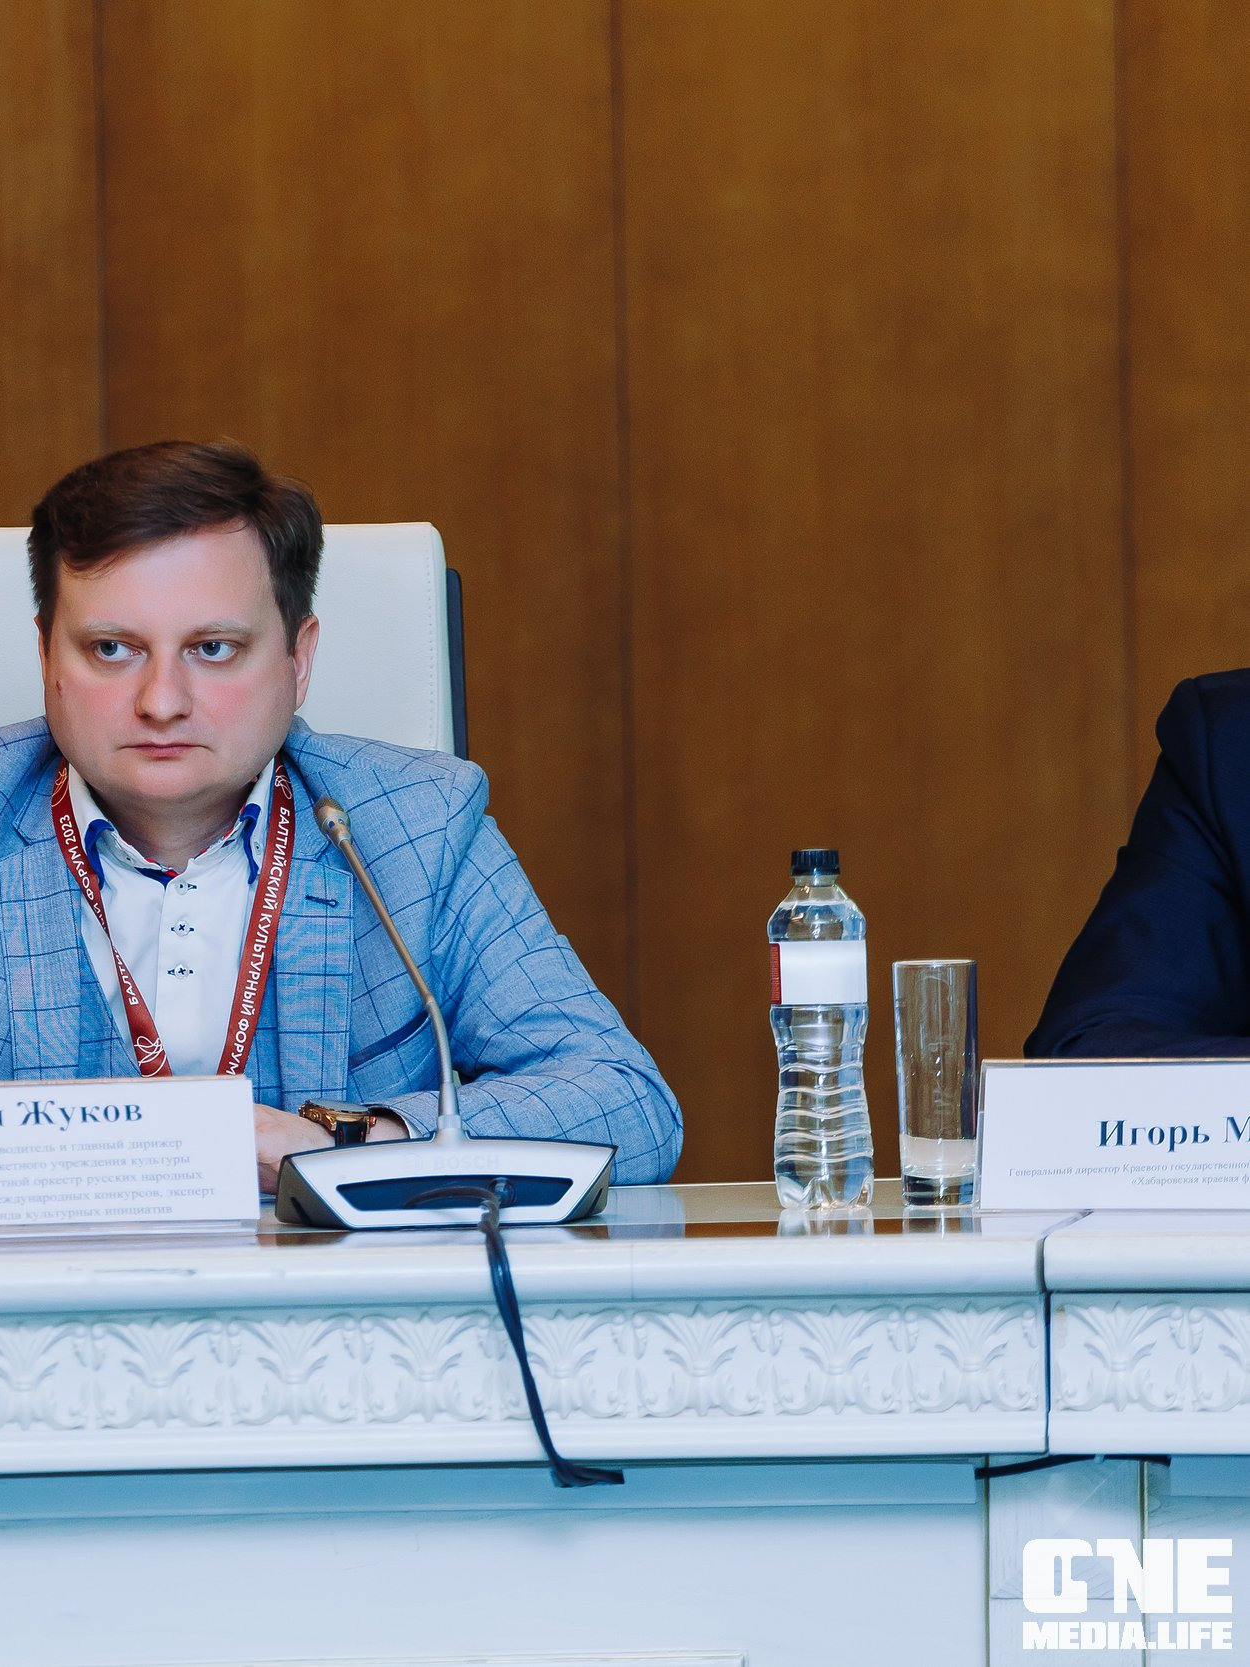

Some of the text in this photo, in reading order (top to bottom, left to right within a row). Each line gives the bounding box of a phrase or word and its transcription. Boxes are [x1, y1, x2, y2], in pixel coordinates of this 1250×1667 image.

[59, 814, 77, 846] 2023
[68, 845, 95, 901] ФОРУМ
[226, 806, 291, 1076] БАЛТИЙСКИЙ КУЛЬТУРНЫЙ ФОРУМ
[16, 1099, 144, 1132] Жуков
[1096, 1119, 1211, 1153] Игорь
[59, 1143, 68, 1152] и
[71, 1140, 125, 1152] главный
[50, 1157, 128, 1171] учреждения
[130, 1154, 191, 1168] культуры
[432, 1154, 500, 1170] BOSCH
[1008, 1166, 1073, 1178] Генеральный
[1074, 1164, 1121, 1176] директор
[1122, 1162, 1168, 1174] Краевого
[33, 1175, 83, 1188] оркестр
[86, 1173, 138, 1186] русских
[140, 1170, 205, 1184] народных
[1201, 1174, 1239, 1184] краевая
[168, 1186, 216, 1199] эксперт
[24, 1207, 102, 1222] культурных
[104, 1204, 174, 1216] инициатив
